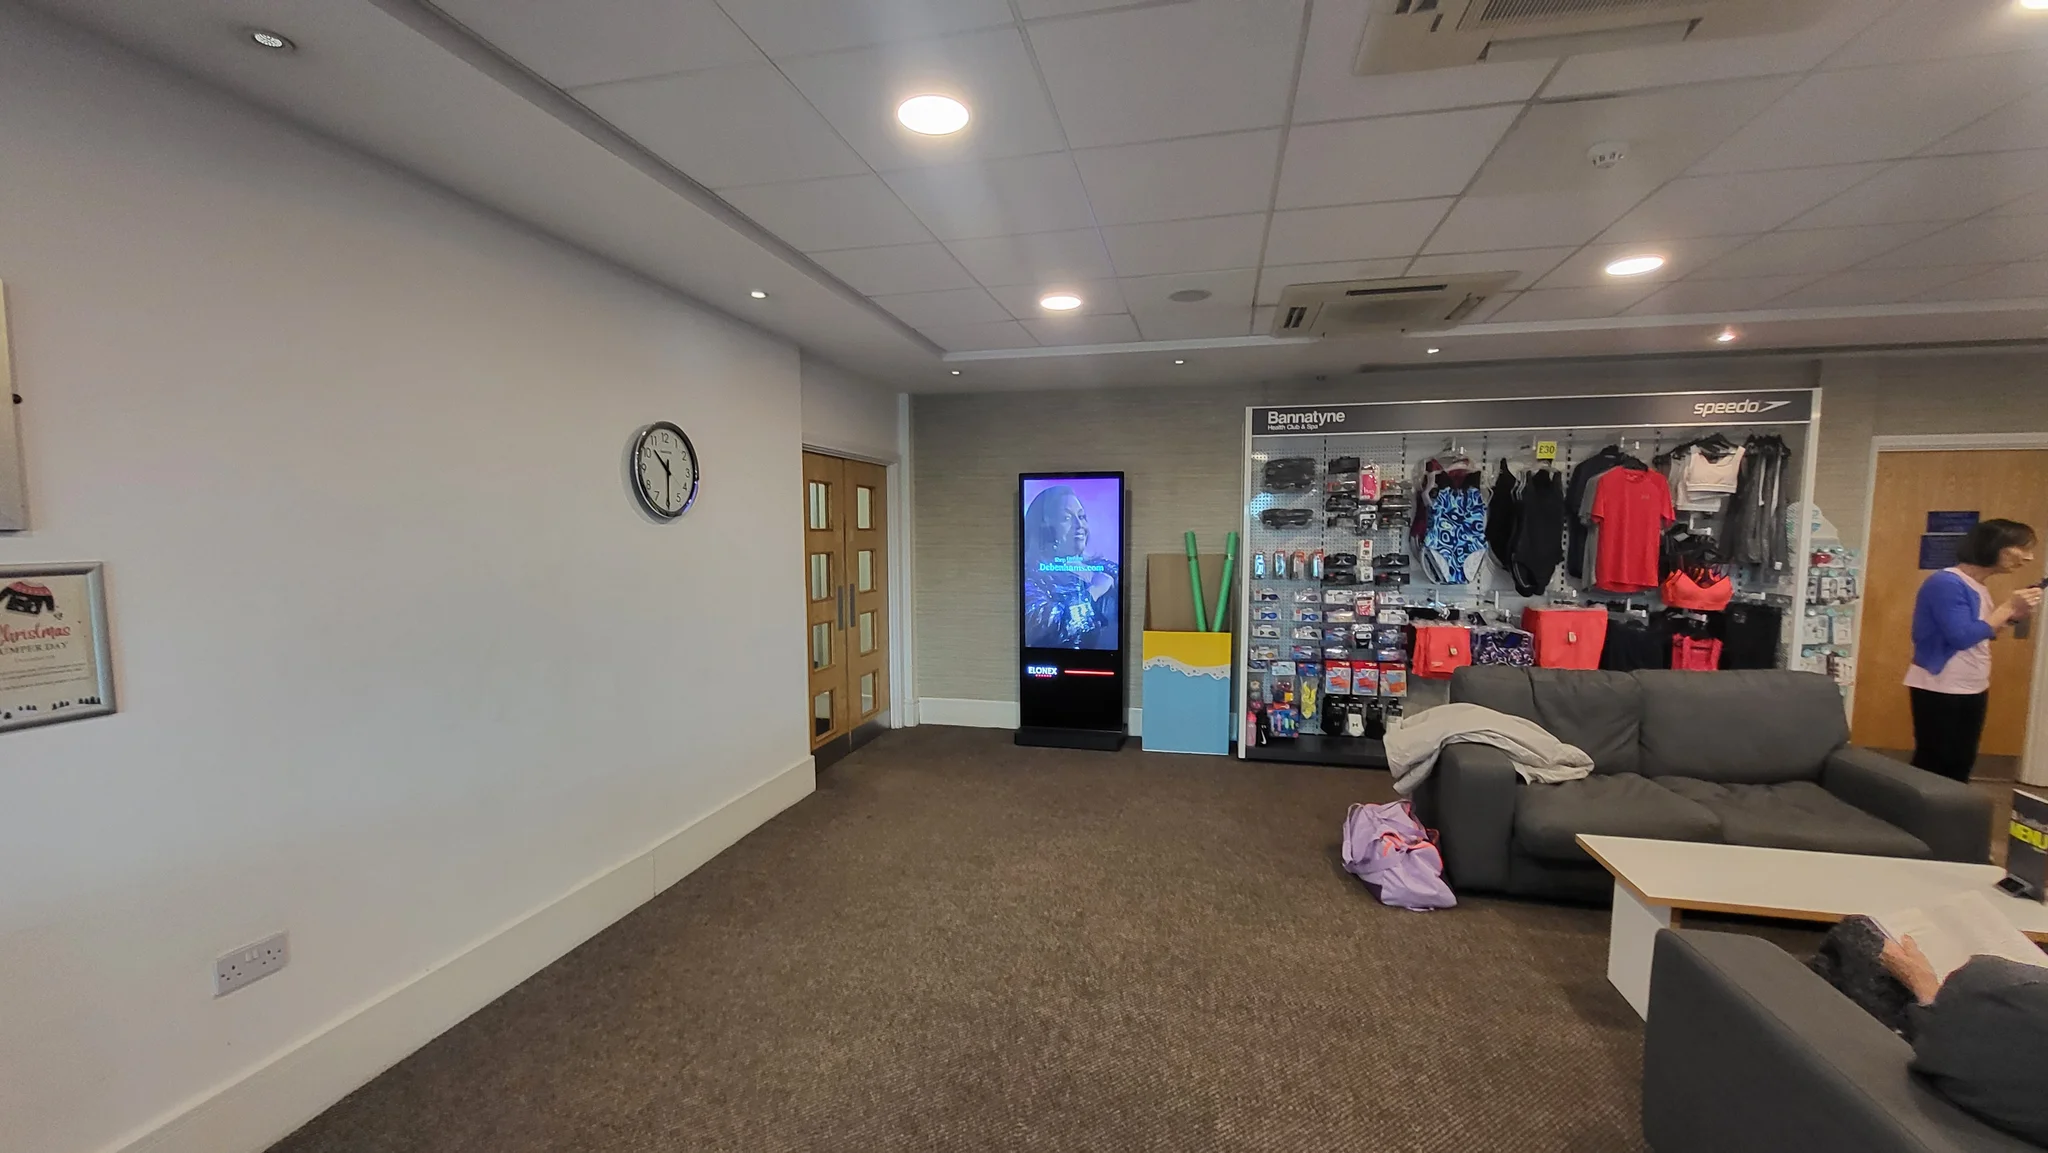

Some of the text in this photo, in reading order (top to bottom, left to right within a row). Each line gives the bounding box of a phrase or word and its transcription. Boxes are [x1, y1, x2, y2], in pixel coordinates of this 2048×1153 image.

[1693, 399, 1760, 417] speedo
[1267, 410, 1346, 427] Bannatyne
[650, 435, 658, 446] 11
[661, 432, 669, 443] 12
[641, 446, 651, 458] 10
[1539, 445, 1555, 454] £30
[681, 451, 687, 461] 2
[641, 463, 647, 473] 9
[685, 468, 690, 478] 3
[646, 480, 651, 490] 8
[682, 482, 688, 491] 4
[654, 490, 659, 500] 7
[676, 493, 681, 502] 5
[1039, 562, 1105, 572] Debenhams.com
[0, 641, 69, 655] UMPER DAY
[1027, 666, 1058, 675] ELONEX
